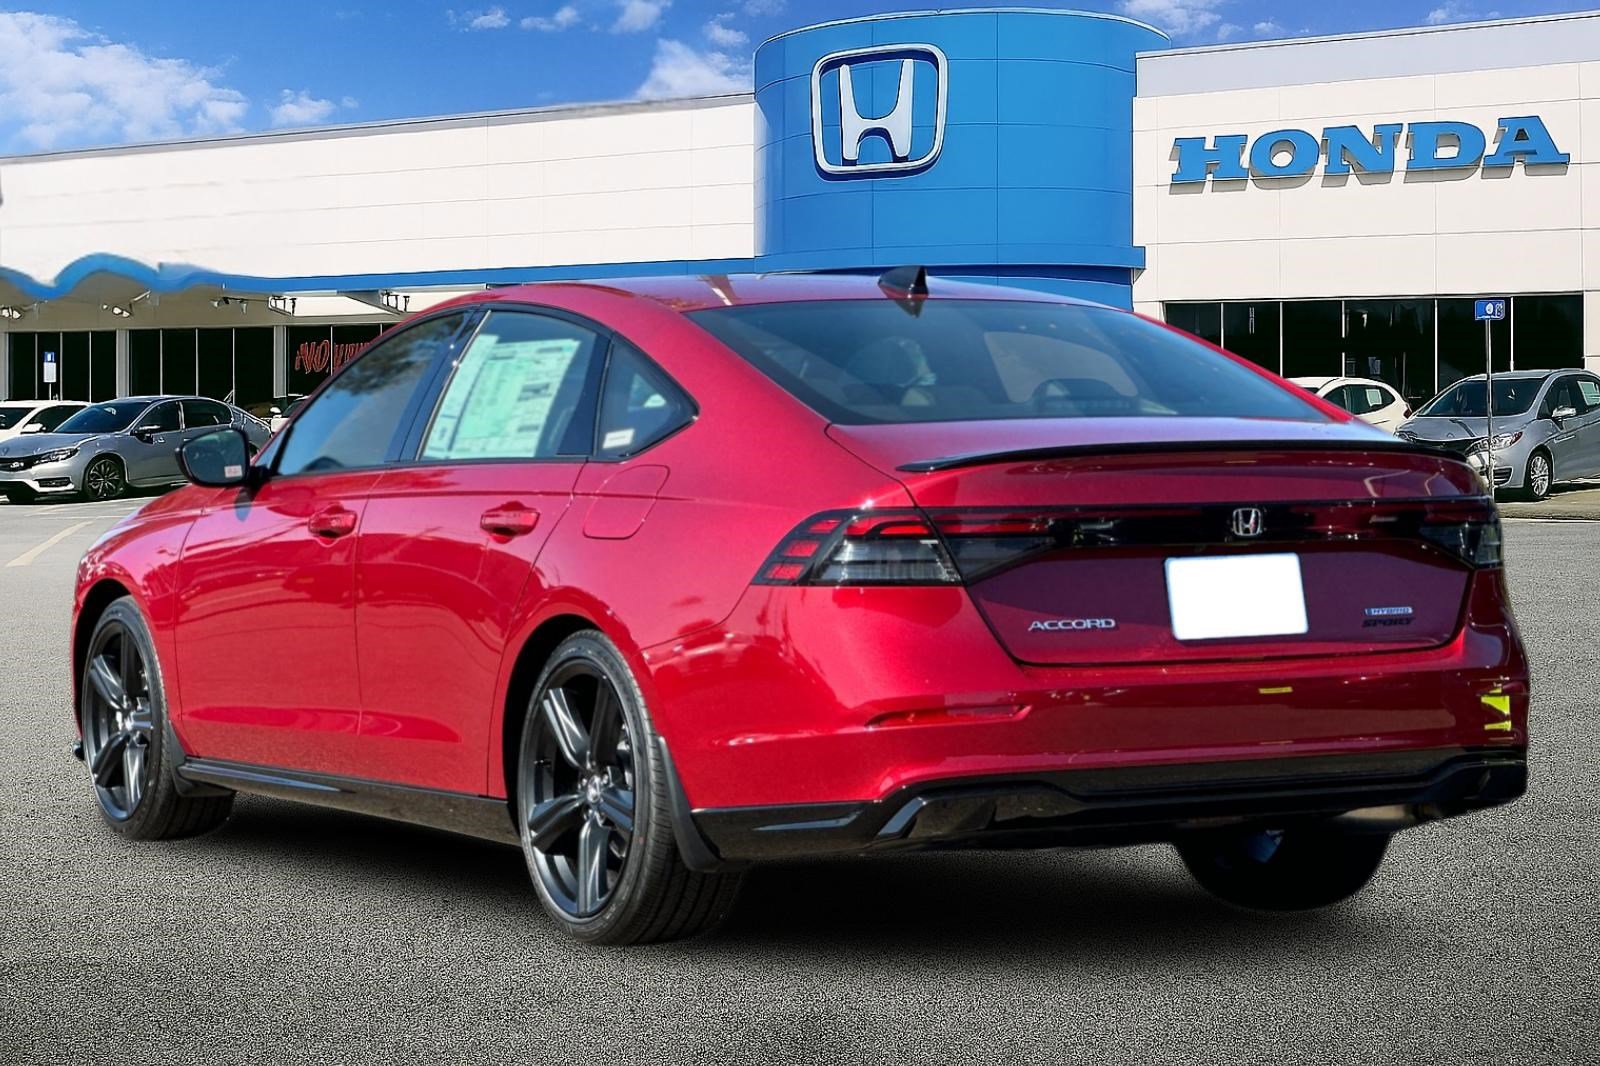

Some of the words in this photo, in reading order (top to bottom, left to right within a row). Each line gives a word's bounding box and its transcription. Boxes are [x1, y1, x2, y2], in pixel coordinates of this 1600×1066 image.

[1171, 115, 1571, 184] HONDA
[1028, 618, 1116, 631] ACCORD
[1362, 617, 1416, 627] SPORT
